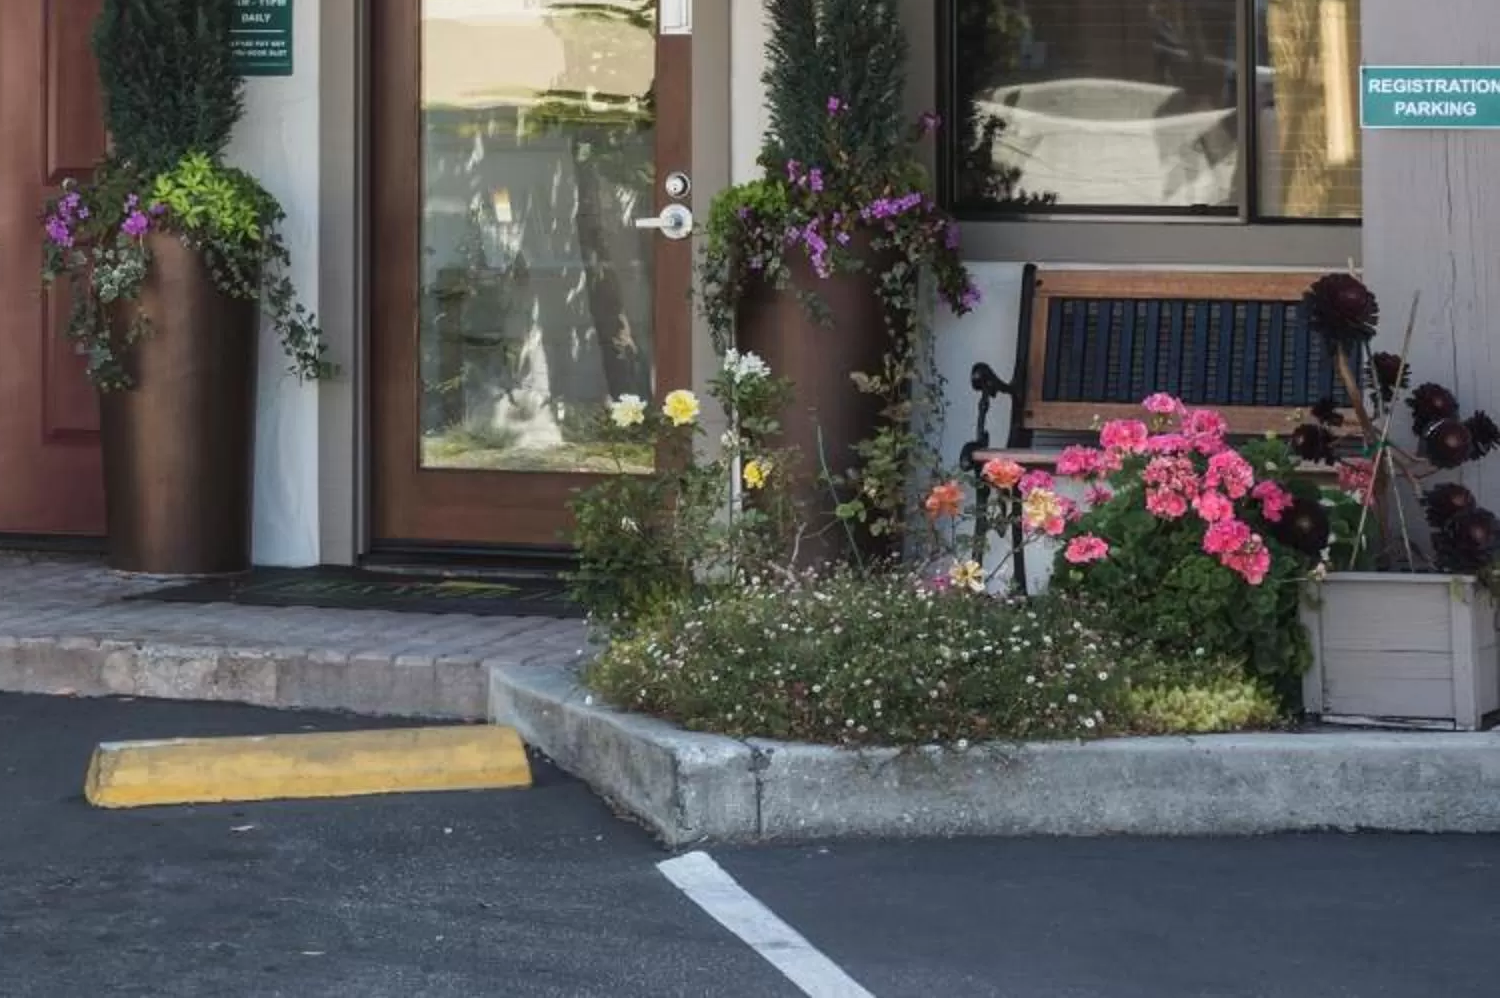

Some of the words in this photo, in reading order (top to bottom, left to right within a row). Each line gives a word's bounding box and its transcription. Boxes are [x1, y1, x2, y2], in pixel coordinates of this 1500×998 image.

[241, 13, 272, 23] DAILY
[1368, 78, 1500, 93] REGISTRATION
[1394, 101, 1477, 116] PARKING
